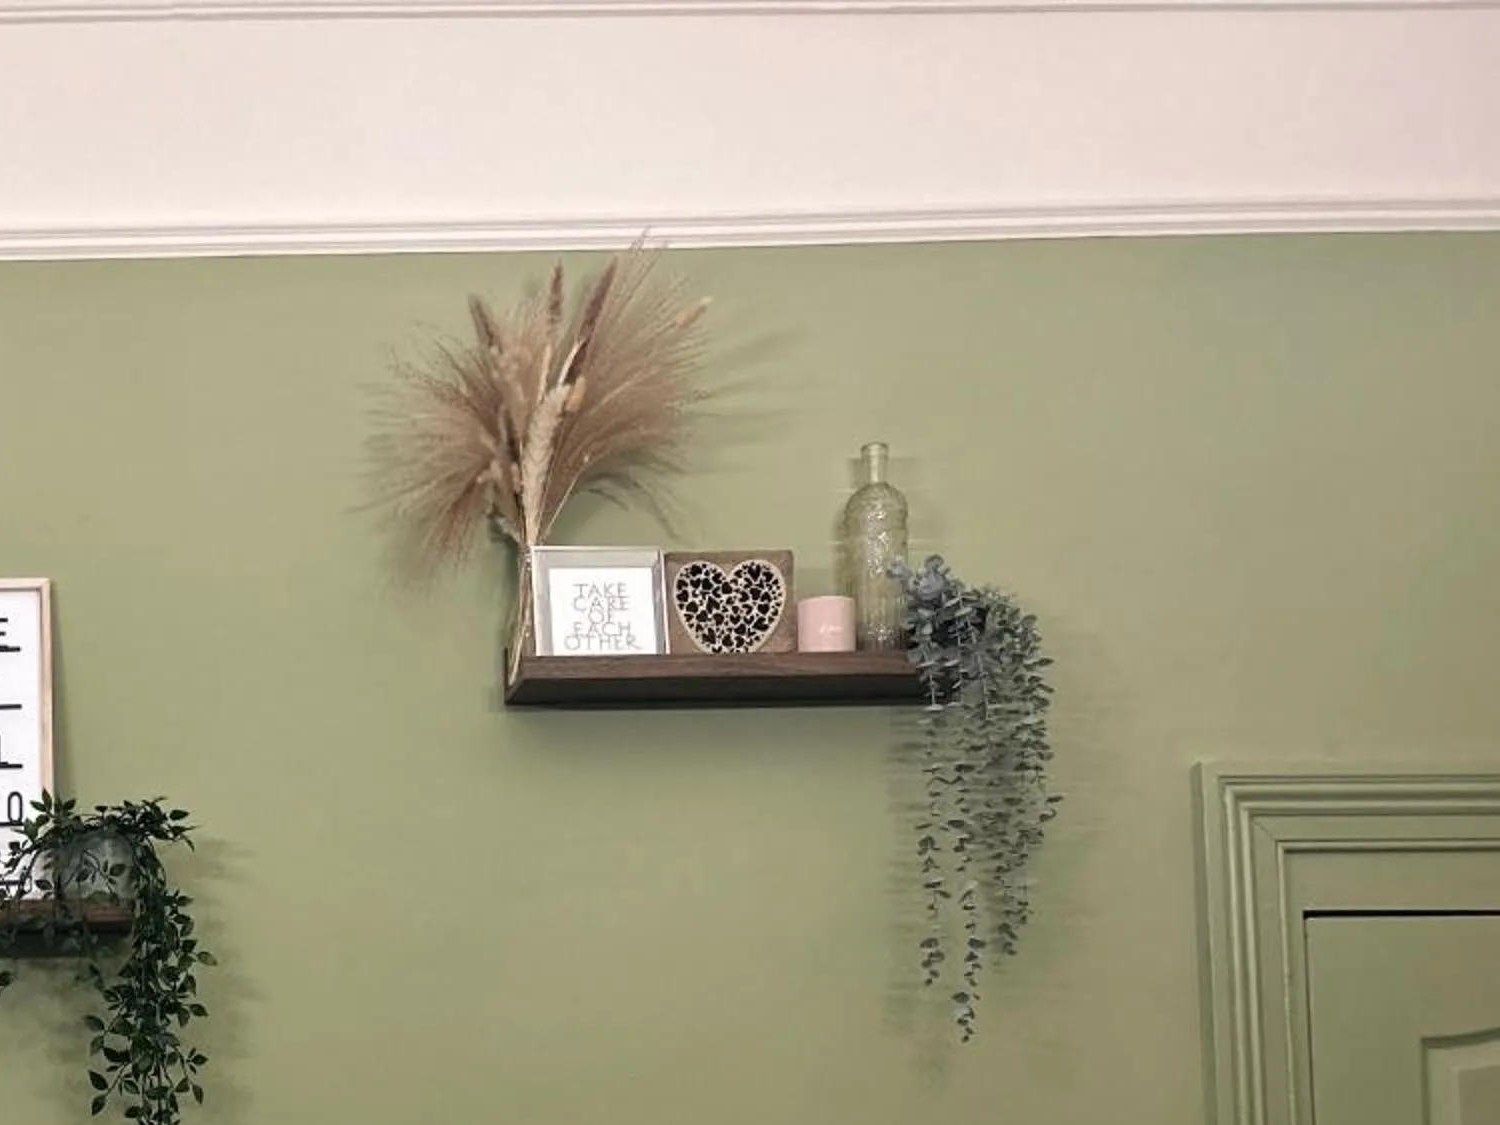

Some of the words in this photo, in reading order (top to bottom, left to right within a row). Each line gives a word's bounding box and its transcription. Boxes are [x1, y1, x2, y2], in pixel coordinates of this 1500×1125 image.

[572, 582, 630, 598] TAKE
[573, 596, 630, 612] CARE
[573, 621, 631, 637] EACH
[564, 634, 643, 651] OTHER
